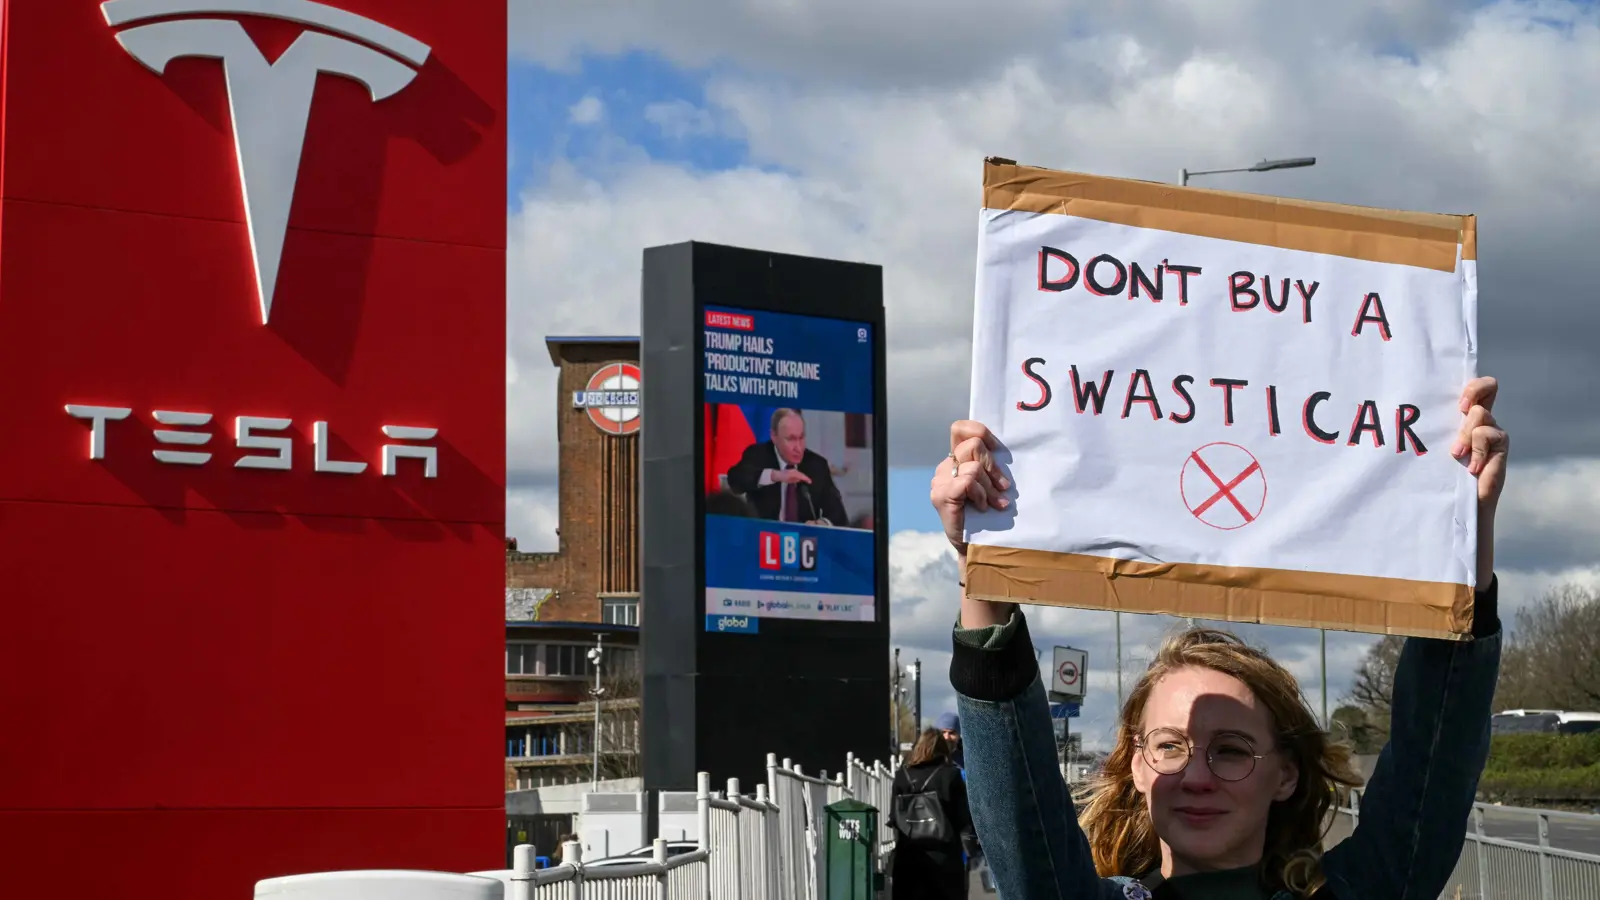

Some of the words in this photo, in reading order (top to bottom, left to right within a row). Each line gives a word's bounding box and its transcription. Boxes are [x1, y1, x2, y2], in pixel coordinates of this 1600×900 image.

[1037, 246, 1202, 305] DON'T
[1228, 270, 1320, 323] BUY
[1350, 292, 1393, 341] A
[708, 314, 731, 327] LATEST
[732, 317, 751, 328] NEWS
[704, 331, 742, 351] TRUMP
[743, 336, 774, 355] HAILS
[776, 360, 820, 380] UKRAINE
[704, 373, 738, 393] TALKS
[739, 377, 766, 396] WITH
[768, 380, 799, 399] PUTIN
[1017, 357, 1428, 456] SWASTICAR
[64, 403, 439, 478] TESLA
[766, 535, 815, 569] LBC
[718, 616, 748, 631] global
